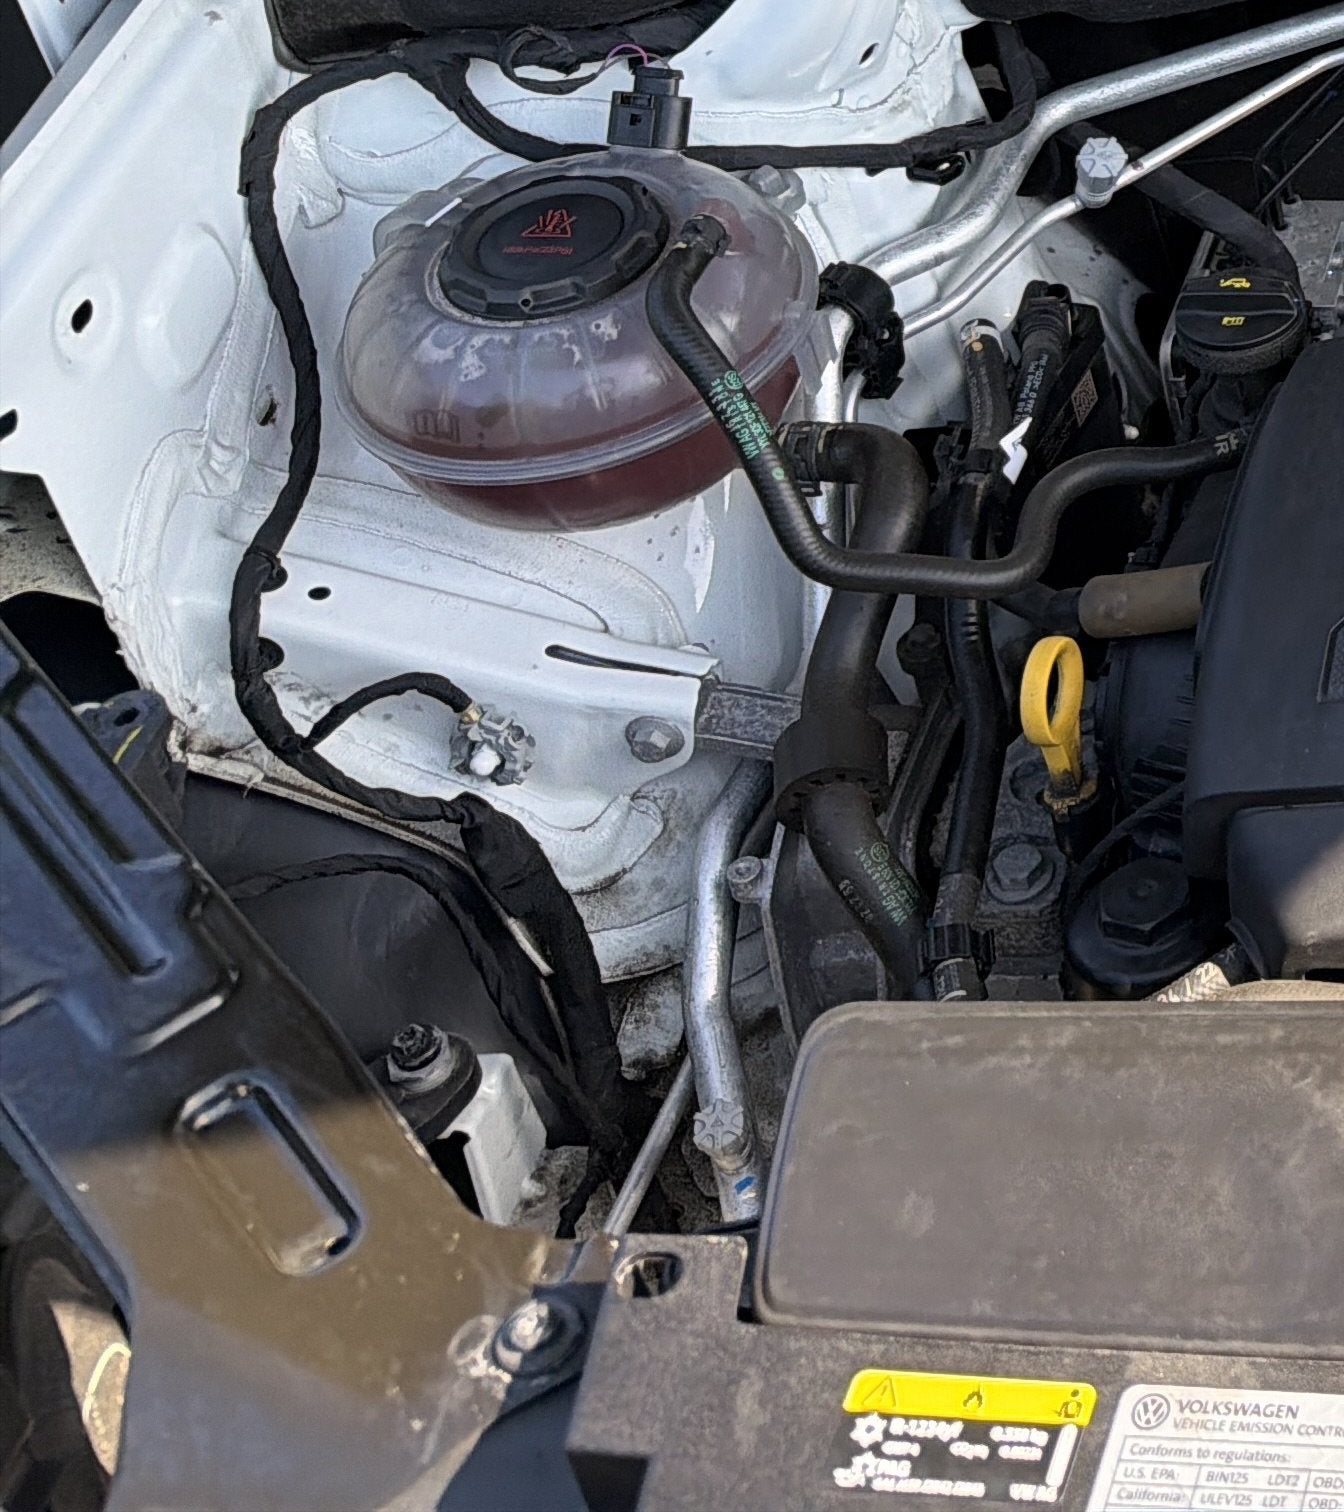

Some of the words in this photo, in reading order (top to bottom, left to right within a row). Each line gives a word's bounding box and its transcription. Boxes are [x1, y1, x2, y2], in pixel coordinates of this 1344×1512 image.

[1176, 1398, 1300, 1419] VOLKSWAGEN
[1174, 1418, 1225, 1433] VEHICLE
[1229, 1420, 1294, 1435] EMISSION
[1130, 1442, 1192, 1458] Conforms
[1196, 1444, 1210, 1459] to
[1212, 1446, 1292, 1463] regulations:
[1123, 1466, 1145, 1479] U.S.
[1205, 1470, 1250, 1484] BIN125
[1266, 1473, 1300, 1487] LDT2
[1262, 1494, 1287, 1508] LDT
